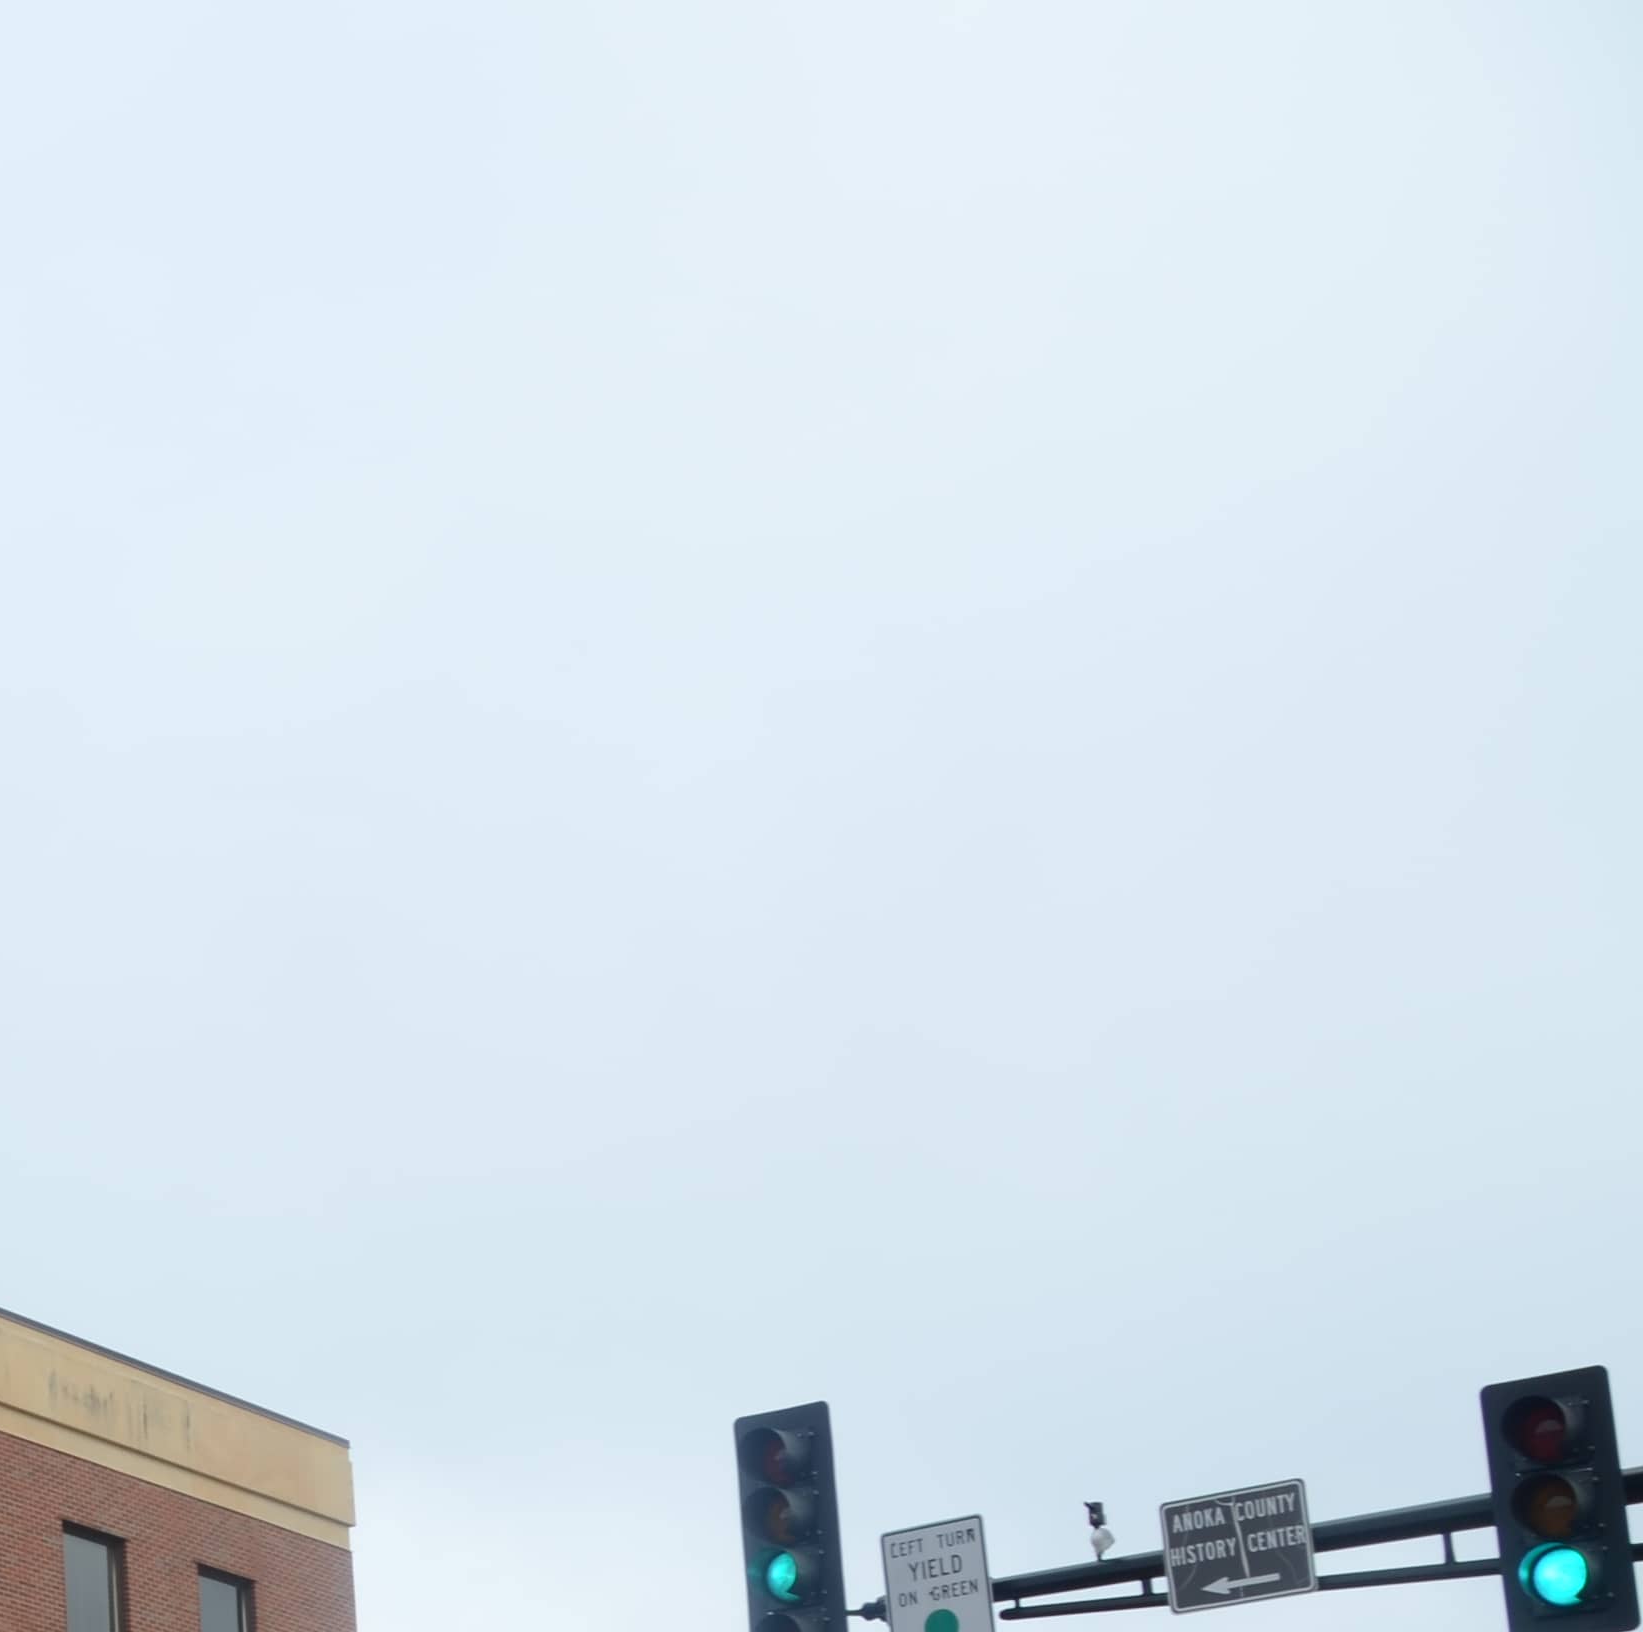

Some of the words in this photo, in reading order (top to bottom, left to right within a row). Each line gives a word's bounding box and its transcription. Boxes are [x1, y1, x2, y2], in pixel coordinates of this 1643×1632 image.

[1172, 1507, 1226, 1533] ANOKA
[1234, 1492, 1295, 1521] COUNTY
[890, 1538, 923, 1558] LEFT
[936, 1528, 976, 1548] TURN
[1169, 1537, 1236, 1567] HISTORY
[1247, 1525, 1308, 1552] CENTER
[908, 1554, 963, 1581] YIELD
[899, 1591, 918, 1607] ON
[929, 1579, 979, 1601] GREEN
